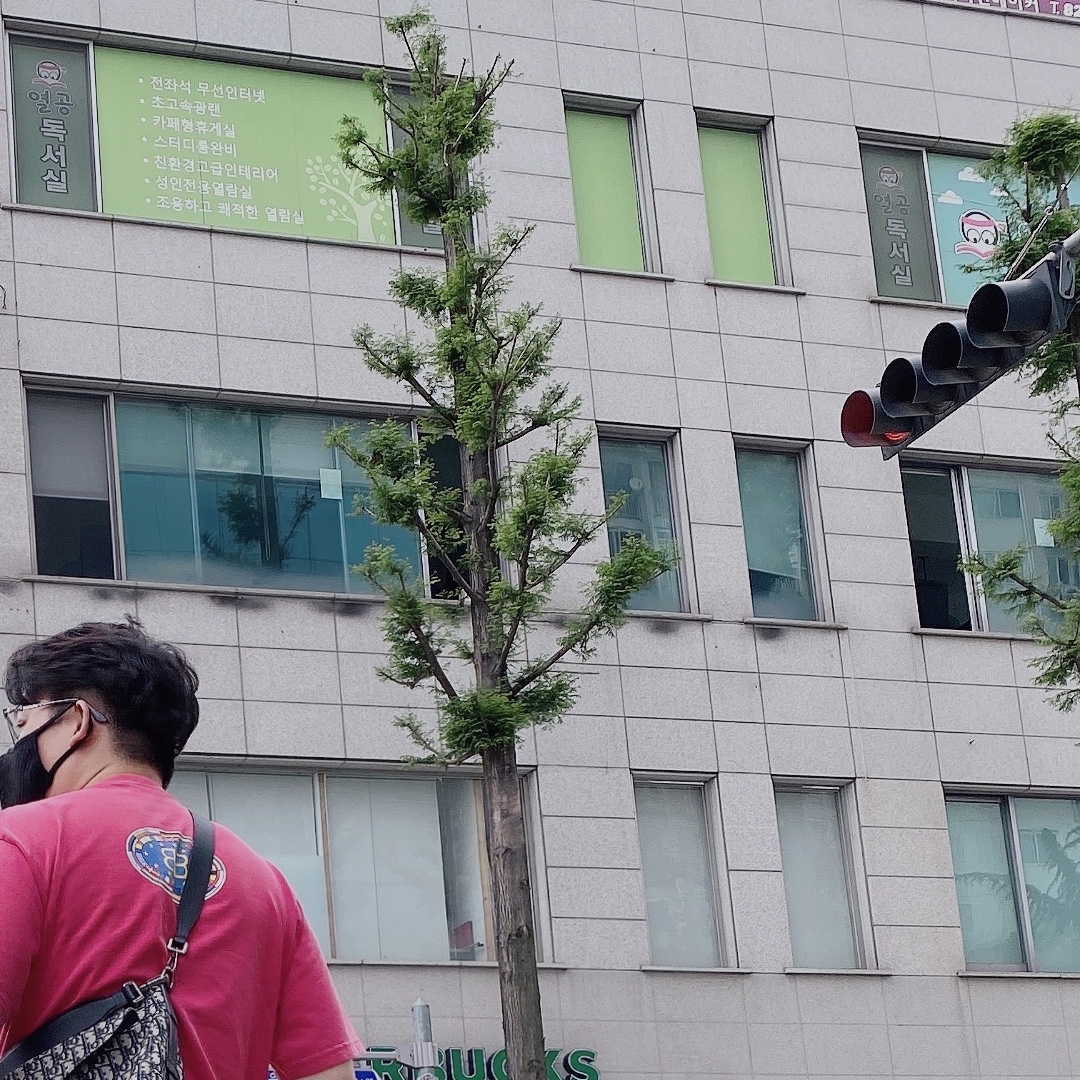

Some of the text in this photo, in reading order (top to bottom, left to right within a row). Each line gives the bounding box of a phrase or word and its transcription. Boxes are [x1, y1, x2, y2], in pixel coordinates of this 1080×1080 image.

[150, 75, 266, 104] 전좌석 무선인터넷
[151, 95, 221, 117] 초고속광랜
[152, 115, 236, 138] 카페형휴게실
[27, 89, 76, 194] 열공 독서실
[153, 135, 237, 158] 스터디룸완비
[154, 155, 279, 182] 친환경고급인테리어
[155, 175, 253, 200] 성인전용열람실
[156, 195, 213, 213] 조용하고
[265, 207, 305, 225] 열람실
[873, 193, 914, 287] 열공 독서실
